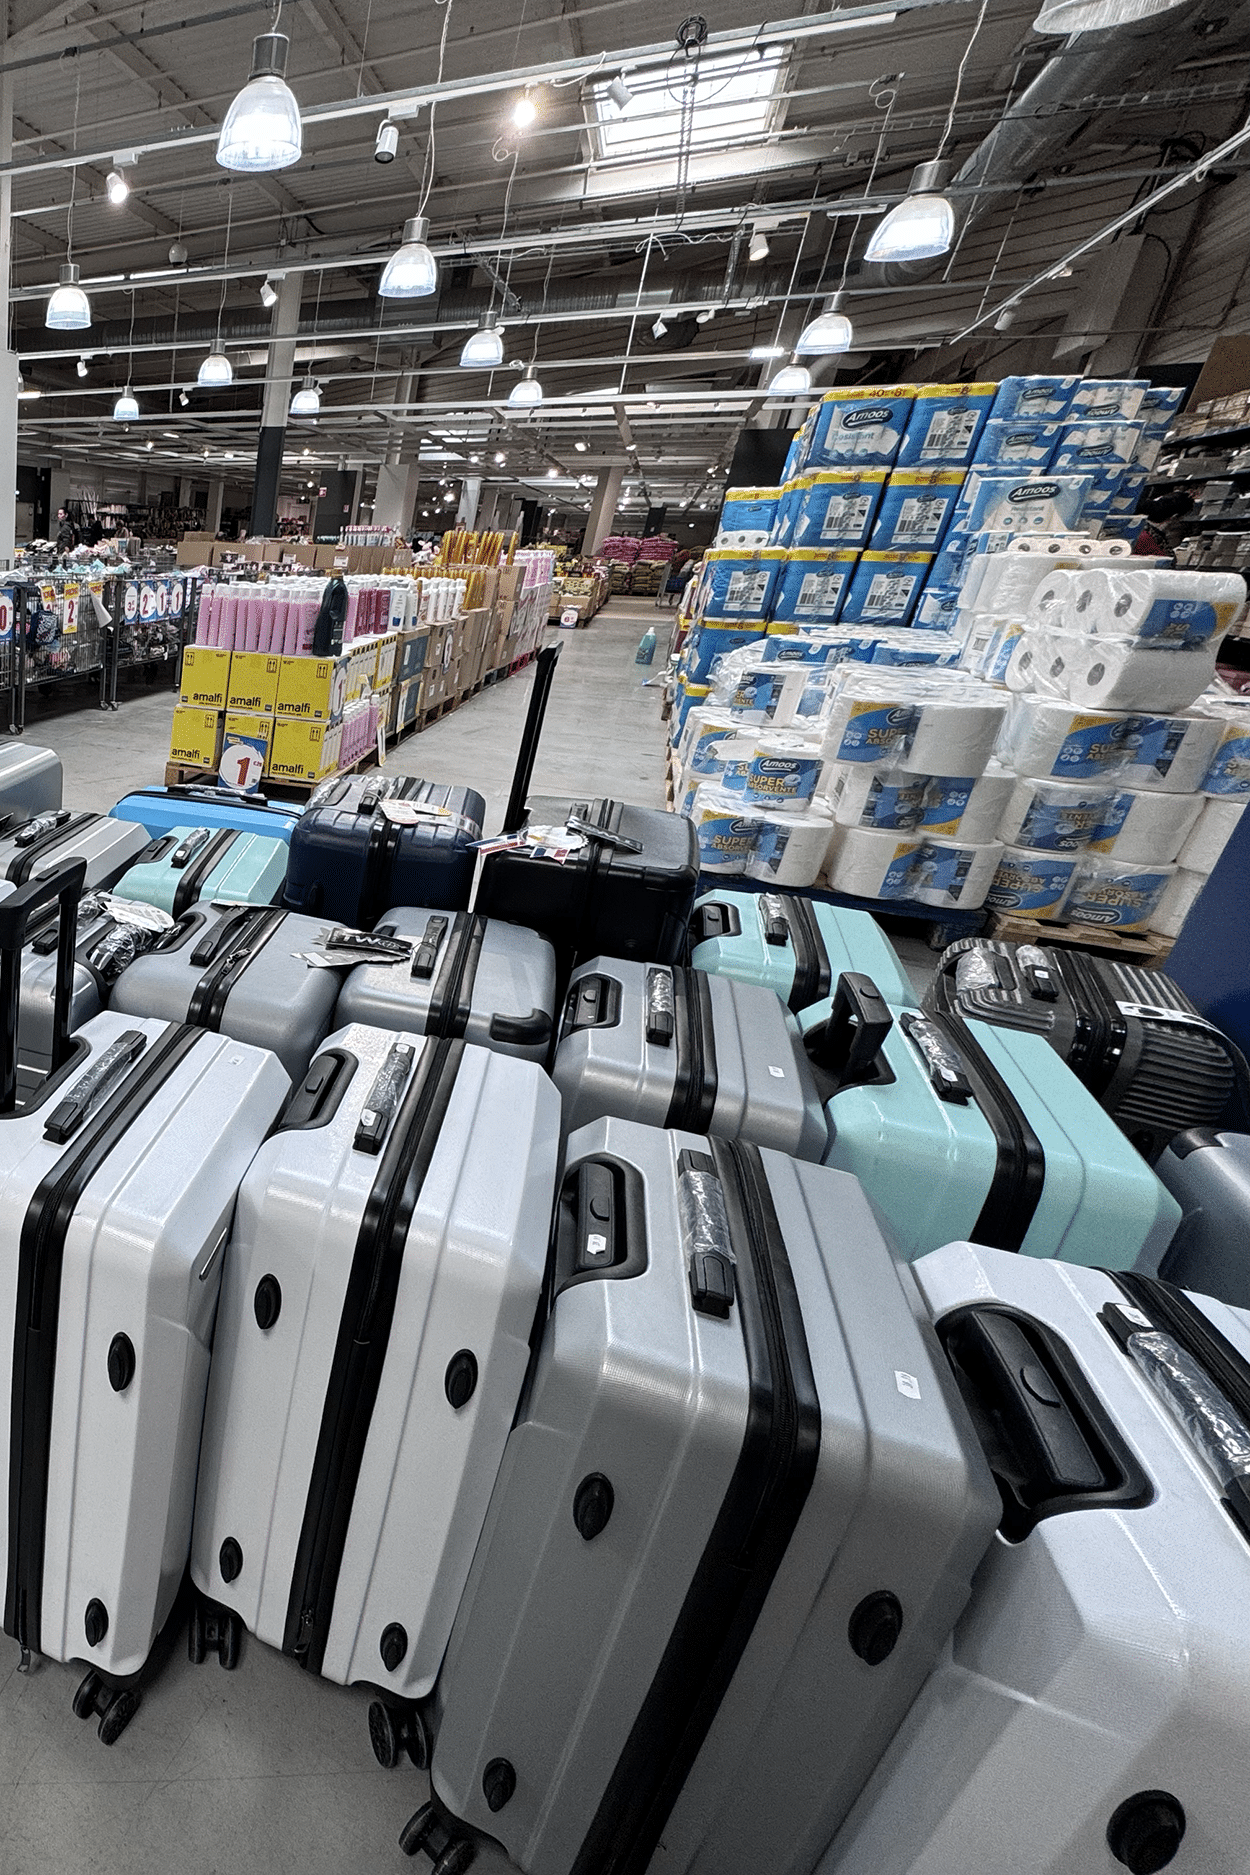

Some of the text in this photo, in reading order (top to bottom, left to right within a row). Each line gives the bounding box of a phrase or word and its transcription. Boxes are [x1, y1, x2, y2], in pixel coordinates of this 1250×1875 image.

[845, 410, 889, 424] Amoos
[1013, 485, 1057, 497] Amoos
[143, 593, 149, 615] 2
[160, 592, 165, 611] 1
[0, 605, 7, 631] 0
[68, 600, 75, 623] 2
[193, 692, 223, 703] amalfi
[229, 696, 261, 707] amalfi
[277, 701, 310, 713] amalfi
[171, 748, 200, 760] amalfi
[272, 762, 304, 774] amalfi
[761, 759, 798, 770] Amoos
[237, 757, 250, 786] 1
[749, 774, 784, 787] SUPER
[1071, 909, 1118, 923] Amoos
